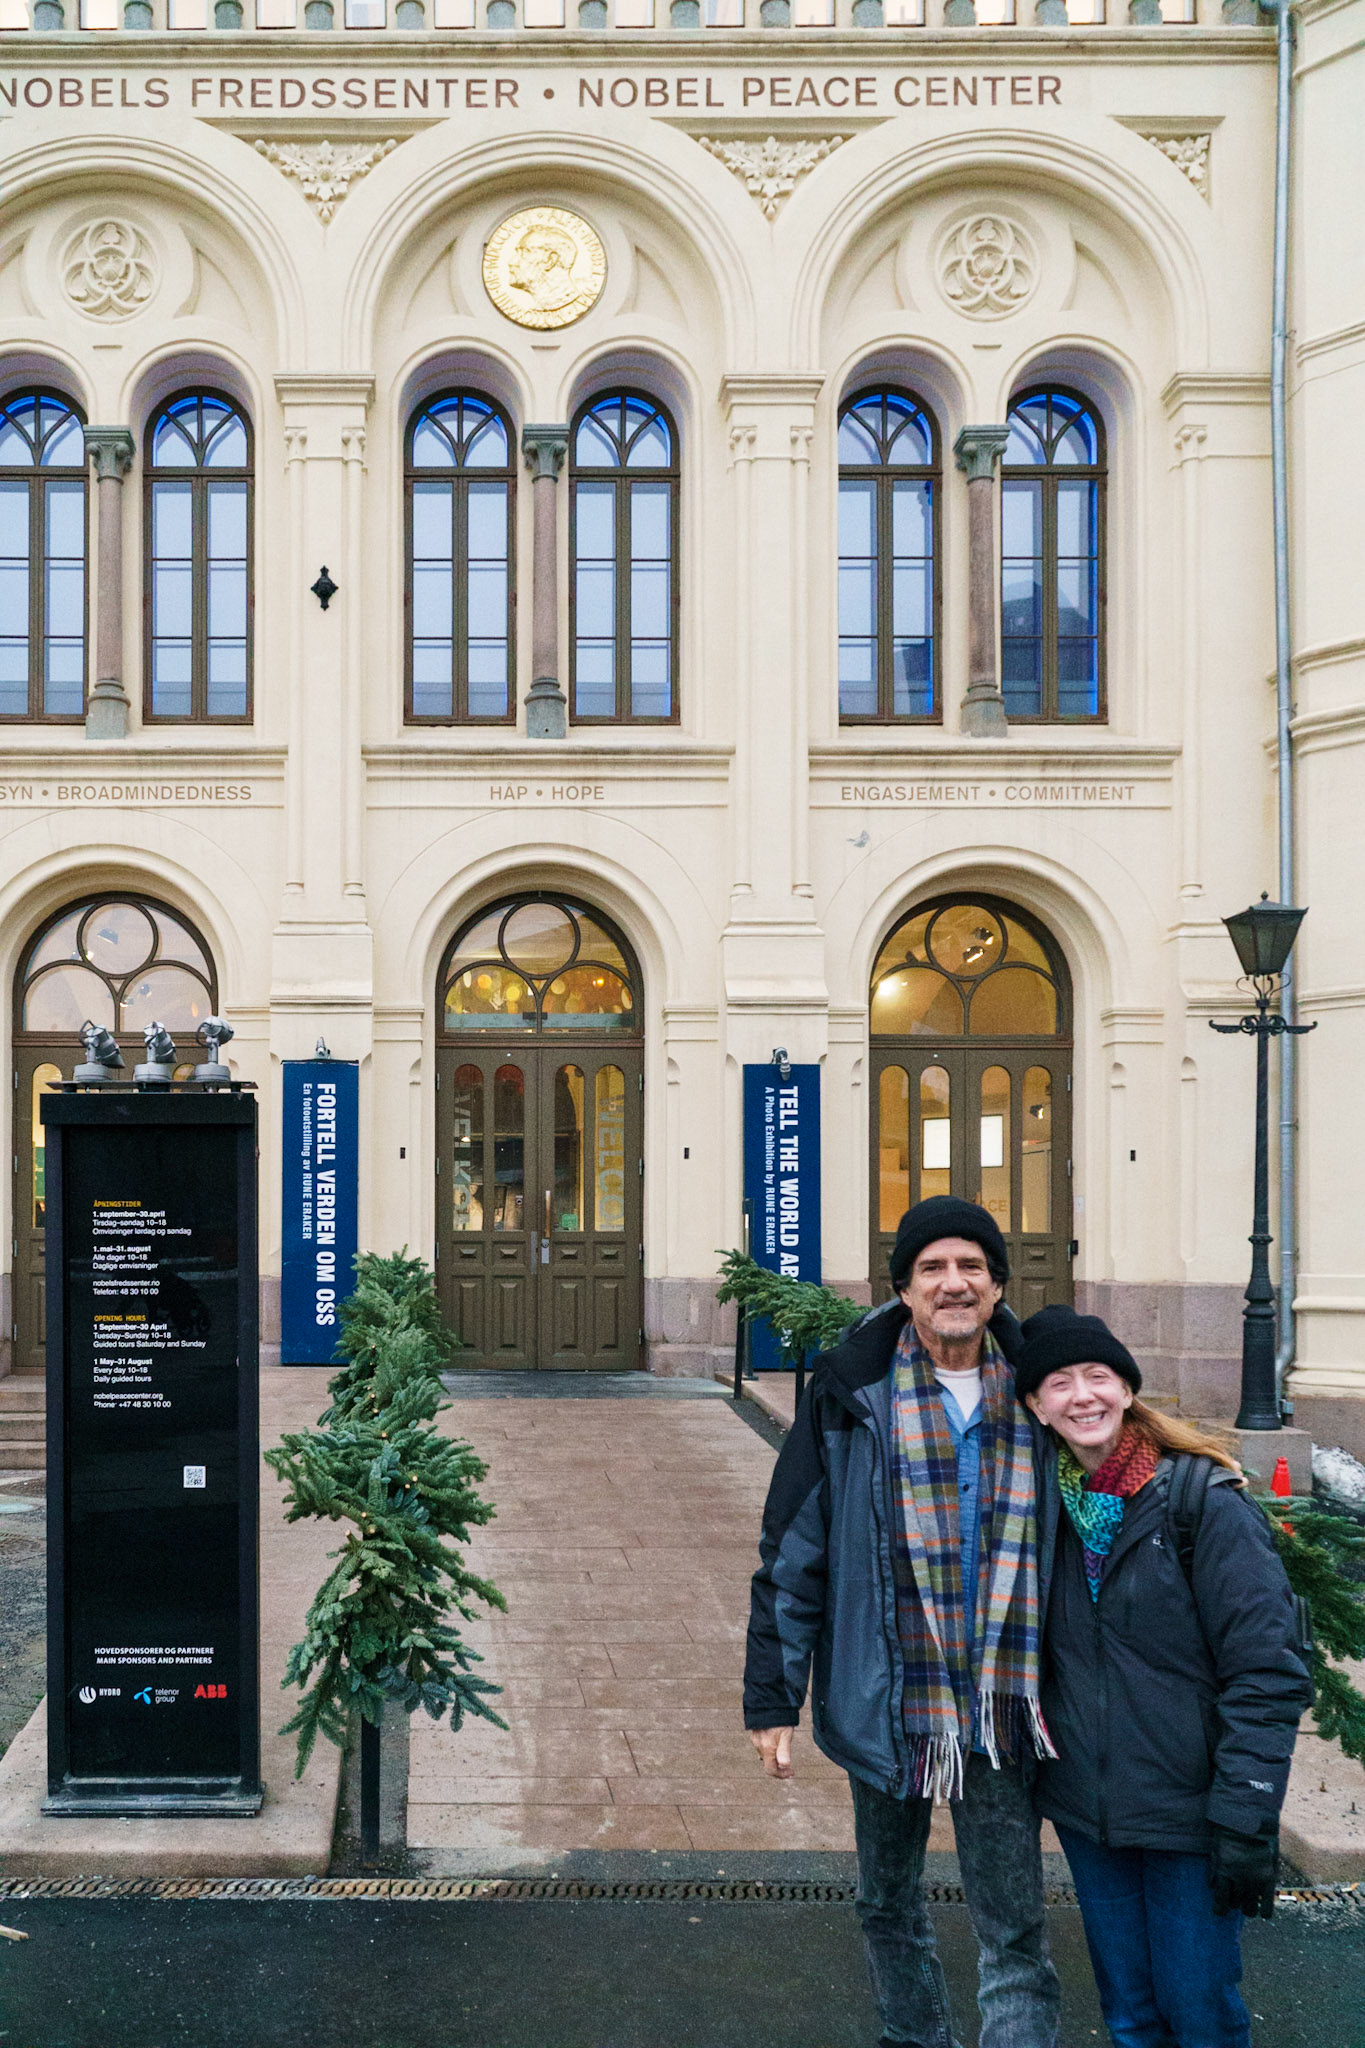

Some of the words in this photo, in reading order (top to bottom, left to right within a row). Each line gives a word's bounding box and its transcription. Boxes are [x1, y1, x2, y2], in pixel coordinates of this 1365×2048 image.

[0, 78, 169, 108] NOBELS
[192, 78, 519, 108] FREDSSENTER
[579, 78, 724, 108] NOBEL
[743, 76, 877, 107] PEACE
[894, 76, 1062, 106] CENTER
[58, 786, 252, 800] BROADMINDEDNESS
[490, 782, 528, 800] HÅP
[552, 786, 604, 800] HOPE
[841, 786, 980, 800] ENGASJEMENT
[1005, 786, 1135, 800] COMMITMENT
[303, 1083, 312, 1094] En
[765, 1096, 774, 1122] Photo
[780, 1086, 798, 1130] TELL
[301, 1098, 312, 1156] fotoutstilling
[317, 1084, 336, 1164] FORTELL
[766, 1126, 775, 1171] Exhibition
[780, 1136, 798, 1172] THE
[302, 1160, 310, 1170] av
[302, 1173, 312, 1198] RUNE
[764, 1174, 775, 1184] by
[316, 1170, 336, 1244] VERDEN
[766, 1188, 775, 1213] RUNE
[780, 1178, 800, 1246] WORLD
[302, 1202, 312, 1240] ERAKER
[766, 1216, 775, 1254] ERAKER
[107, 1254, 125, 1262] dager
[316, 1251, 336, 1282] OM
[316, 1288, 336, 1326] OSS
[94, 1367, 112, 1375] Every
[127, 1358, 152, 1366] August
[99, 1688, 121, 1696] HYDRO
[155, 1696, 175, 1704] group
[194, 1684, 227, 1698] ABB
